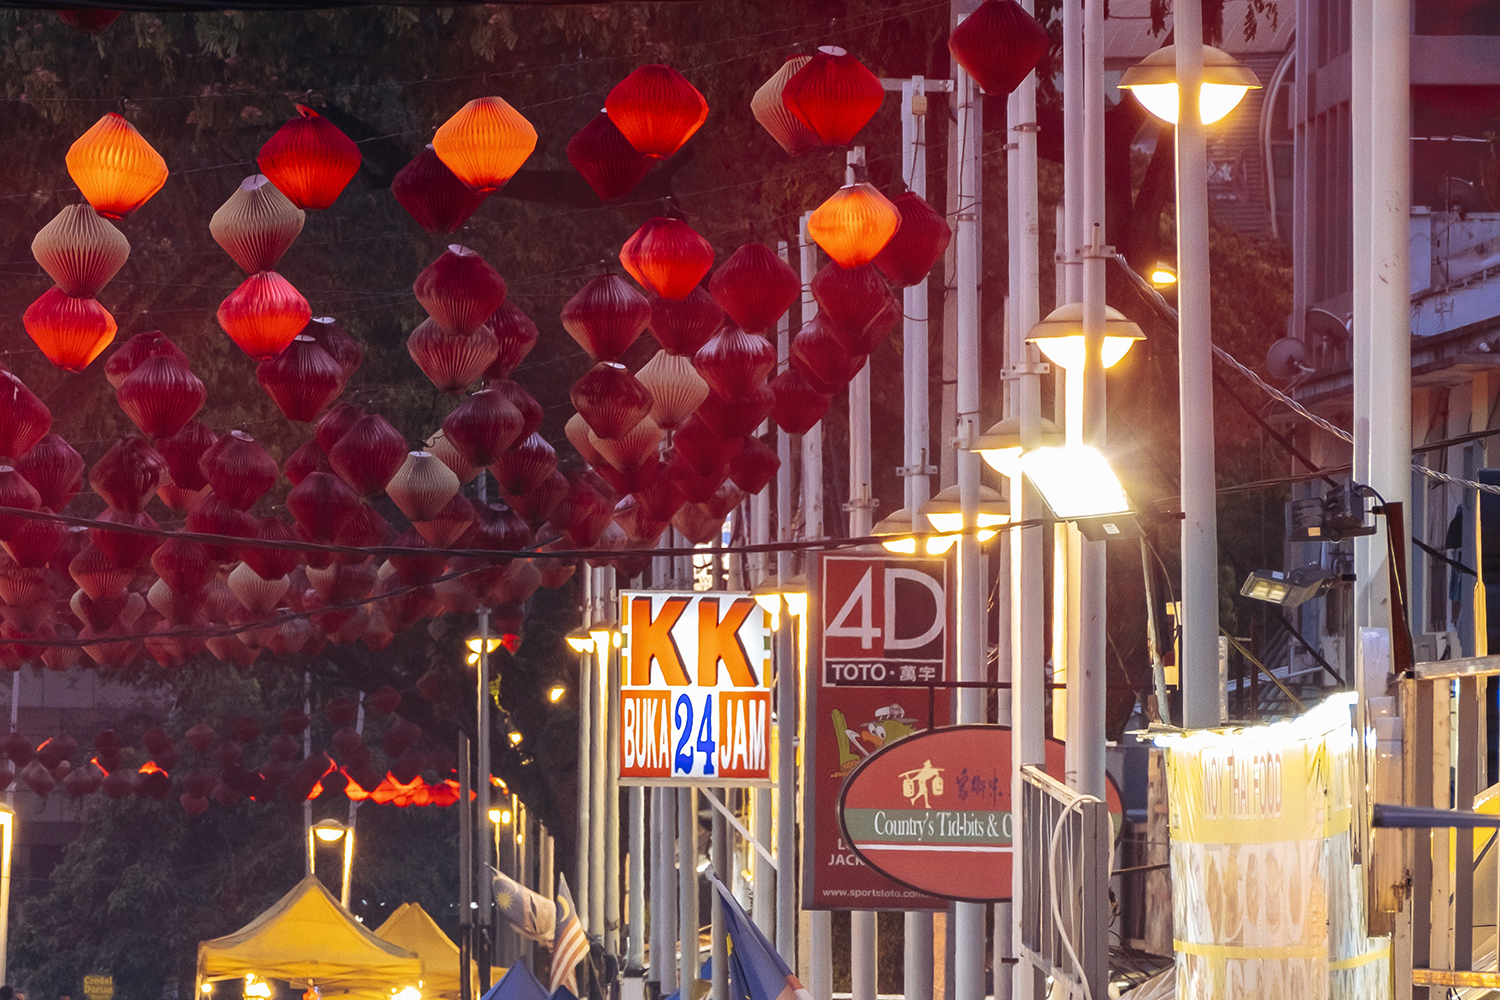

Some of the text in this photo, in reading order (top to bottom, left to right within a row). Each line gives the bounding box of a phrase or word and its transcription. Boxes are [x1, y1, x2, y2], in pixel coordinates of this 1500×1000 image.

[631, 596, 760, 688] KK
[825, 565, 946, 650] 4D
[831, 663, 886, 681] TOTO
[624, 693, 766, 775] BUKA 24 JAM
[1253, 752, 1283, 818] FOOD
[874, 810, 934, 842] Country's
[937, 811, 984, 838] Tid-bits
[986, 813, 1000, 838] &
